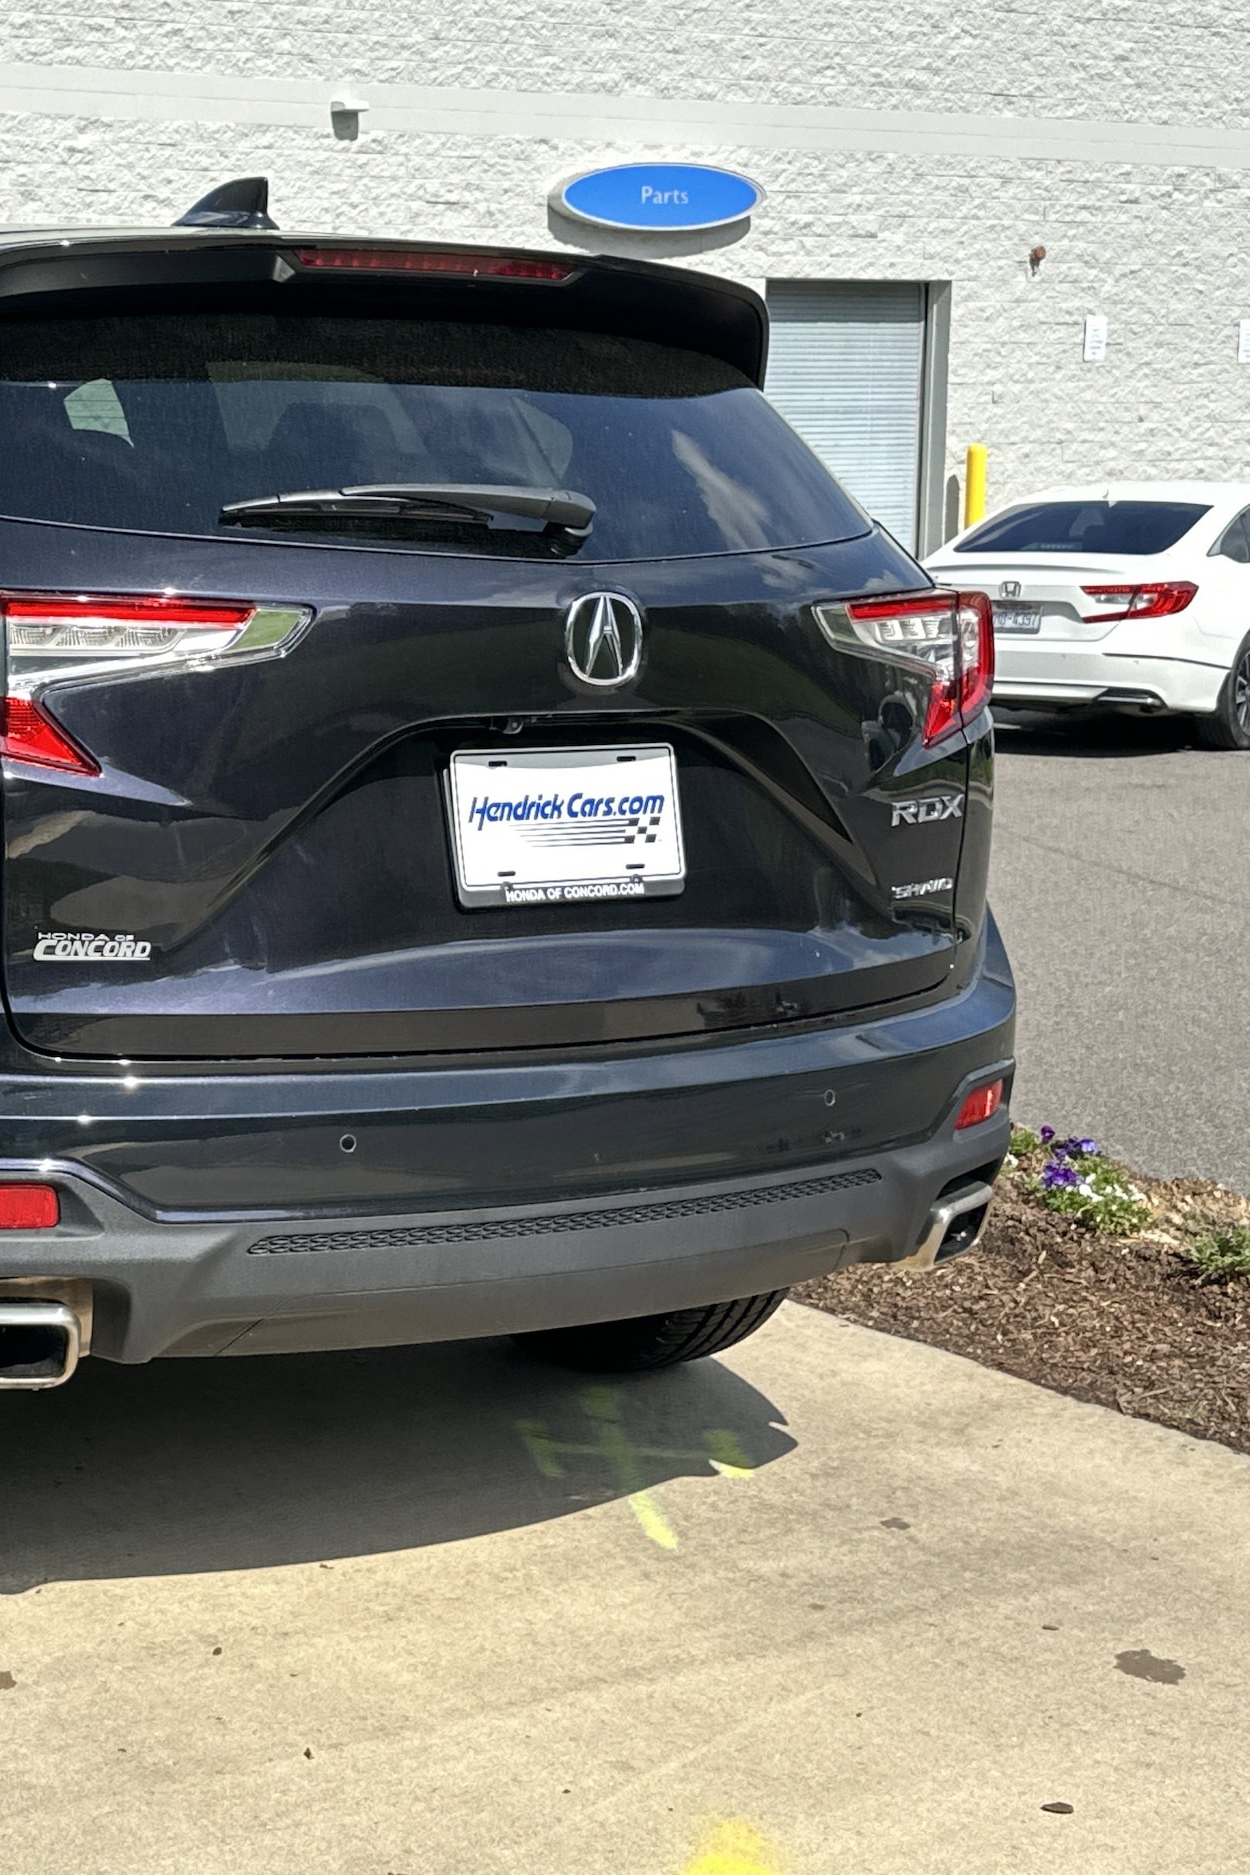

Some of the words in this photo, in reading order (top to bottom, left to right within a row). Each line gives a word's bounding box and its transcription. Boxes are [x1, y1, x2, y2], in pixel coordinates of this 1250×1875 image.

[641, 185, 689, 205] Parts
[891, 794, 964, 827] RDX
[505, 888, 546, 902] HONDA
[547, 887, 562, 899] OF
[564, 883, 645, 898] CONCORD.COM
[38, 932, 110, 941] HONDA
[33, 939, 151, 961] CONCORD
